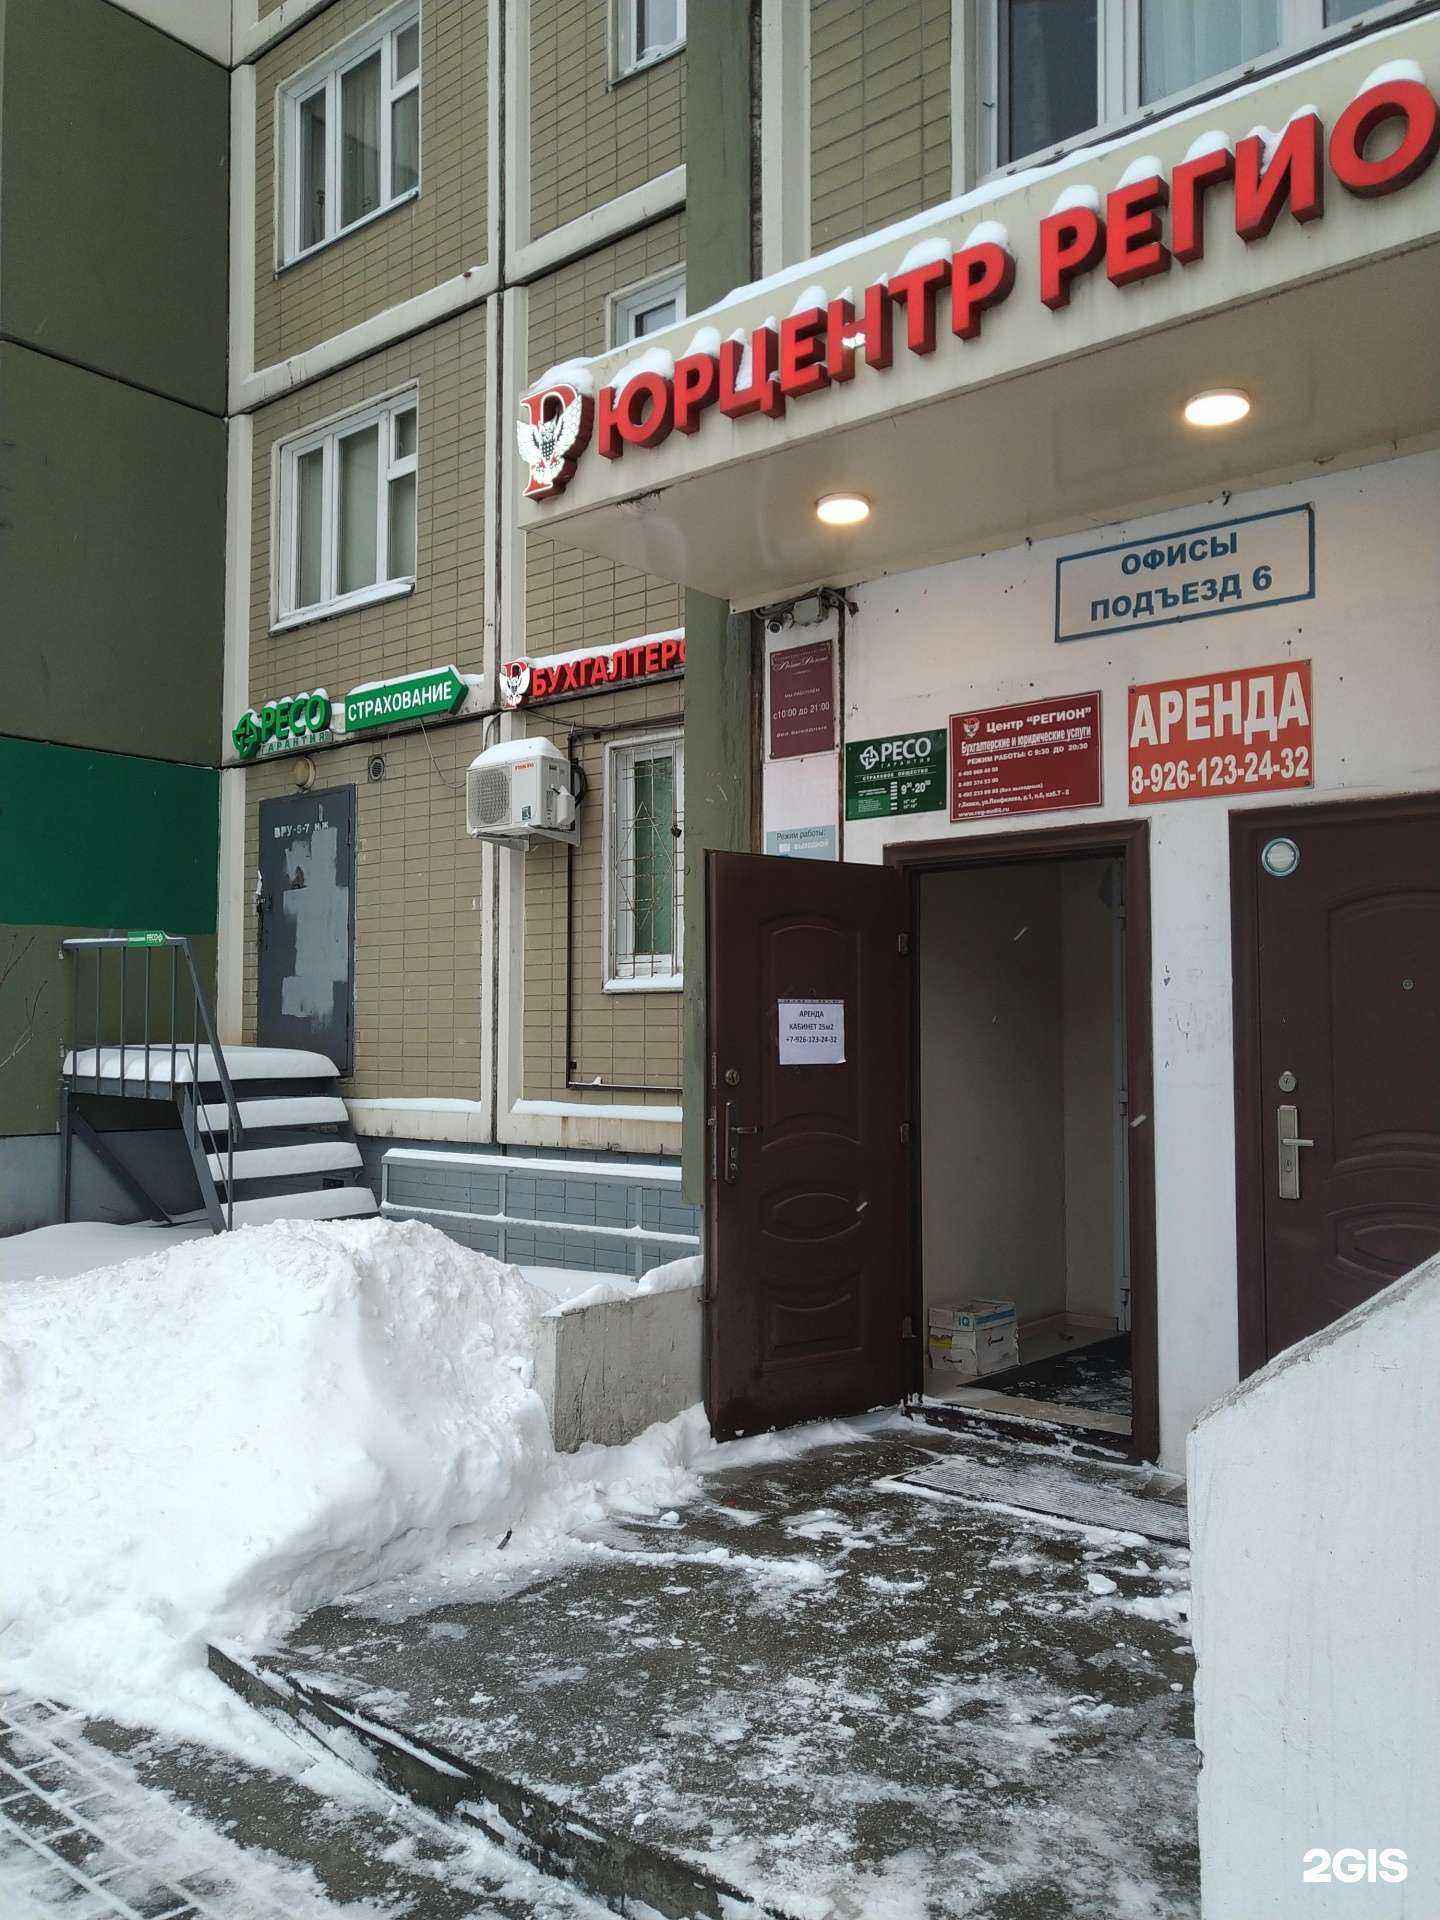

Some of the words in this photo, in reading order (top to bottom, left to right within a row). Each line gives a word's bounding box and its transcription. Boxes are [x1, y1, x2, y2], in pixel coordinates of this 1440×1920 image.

[598, 240, 1015, 461] ЮРЦЕНТР
[1040, 78, 1440, 311] РЕГИО
[1121, 531, 1238, 575] ОФИСЫ
[1091, 573, 1242, 621] ПОДЪЕЗД
[1252, 565, 1272, 591] 6
[261, 694, 332, 743] РЕСО
[348, 681, 452, 722] СТРАХОВАНИЕ
[1130, 672, 1310, 748] АРЕНДА
[262, 731, 331, 755] ГАРАНТИЯ
[961, 738, 1010, 756] Бухгалтерские
[1011, 737, 1016, 747] и
[1017, 729, 1065, 747] юридические
[1066, 725, 1092, 741] услуги
[986, 719, 1023, 734] Центр
[881, 737, 932, 762] РЕСО
[967, 756, 993, 765] РЕЖИМ
[1053, 746, 1065, 754] ДО
[1131, 745, 1310, 795] 8-926-123-24-32
[789, 1023, 817, 1031] КАБИНЕТ
[799, 1010, 825, 1018] АРЕНДА
